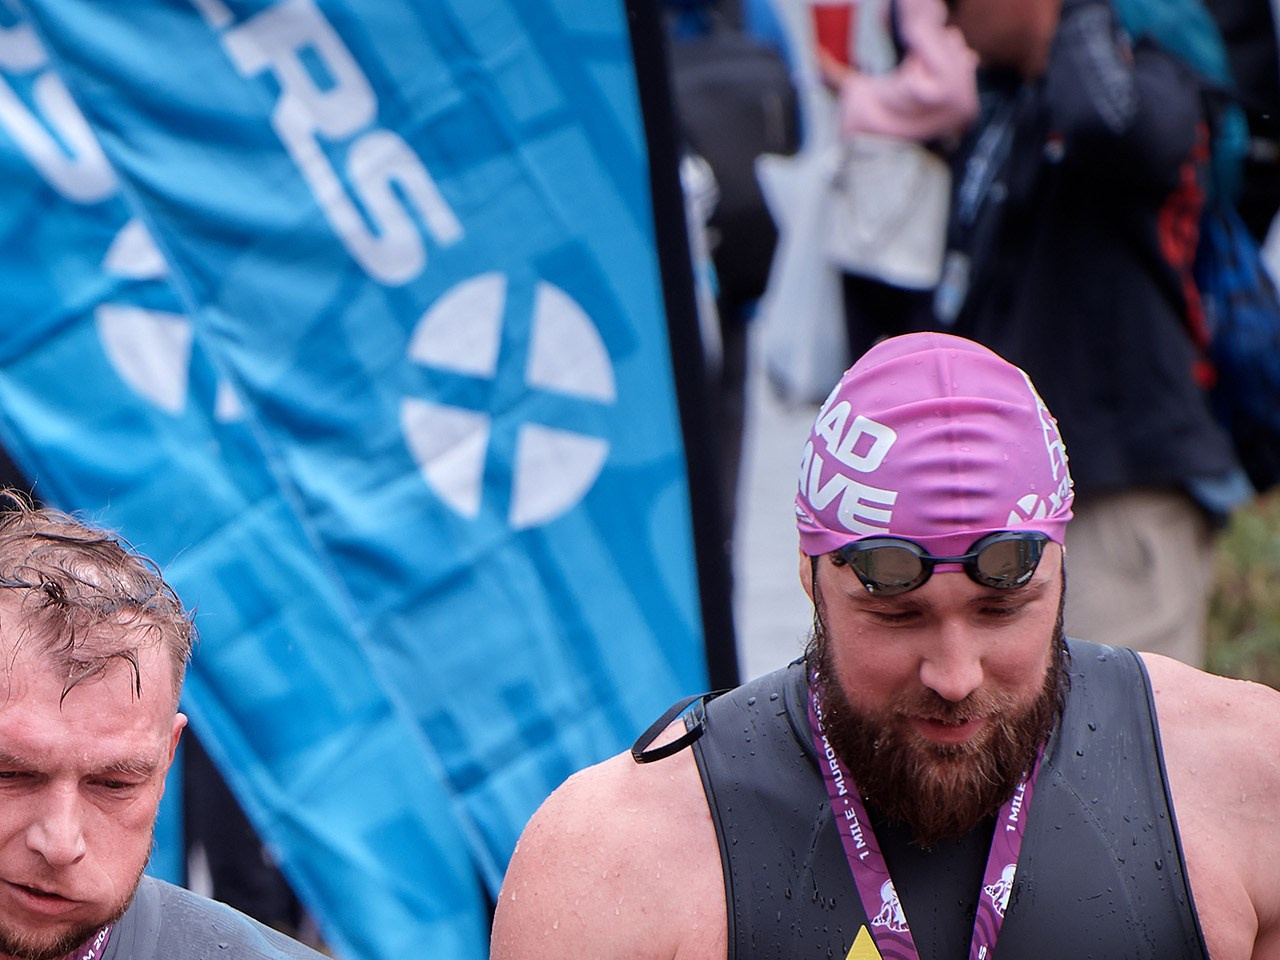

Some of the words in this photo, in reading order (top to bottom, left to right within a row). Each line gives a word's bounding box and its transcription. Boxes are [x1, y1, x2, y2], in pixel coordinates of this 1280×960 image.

[195, 0, 464, 286] RS
[822, 735, 848, 797] MUROM
[1008, 782, 1027, 822] MILE
[844, 806, 867, 850] MILE
[1006, 823, 1017, 832] 1
[859, 850, 870, 861] 1
